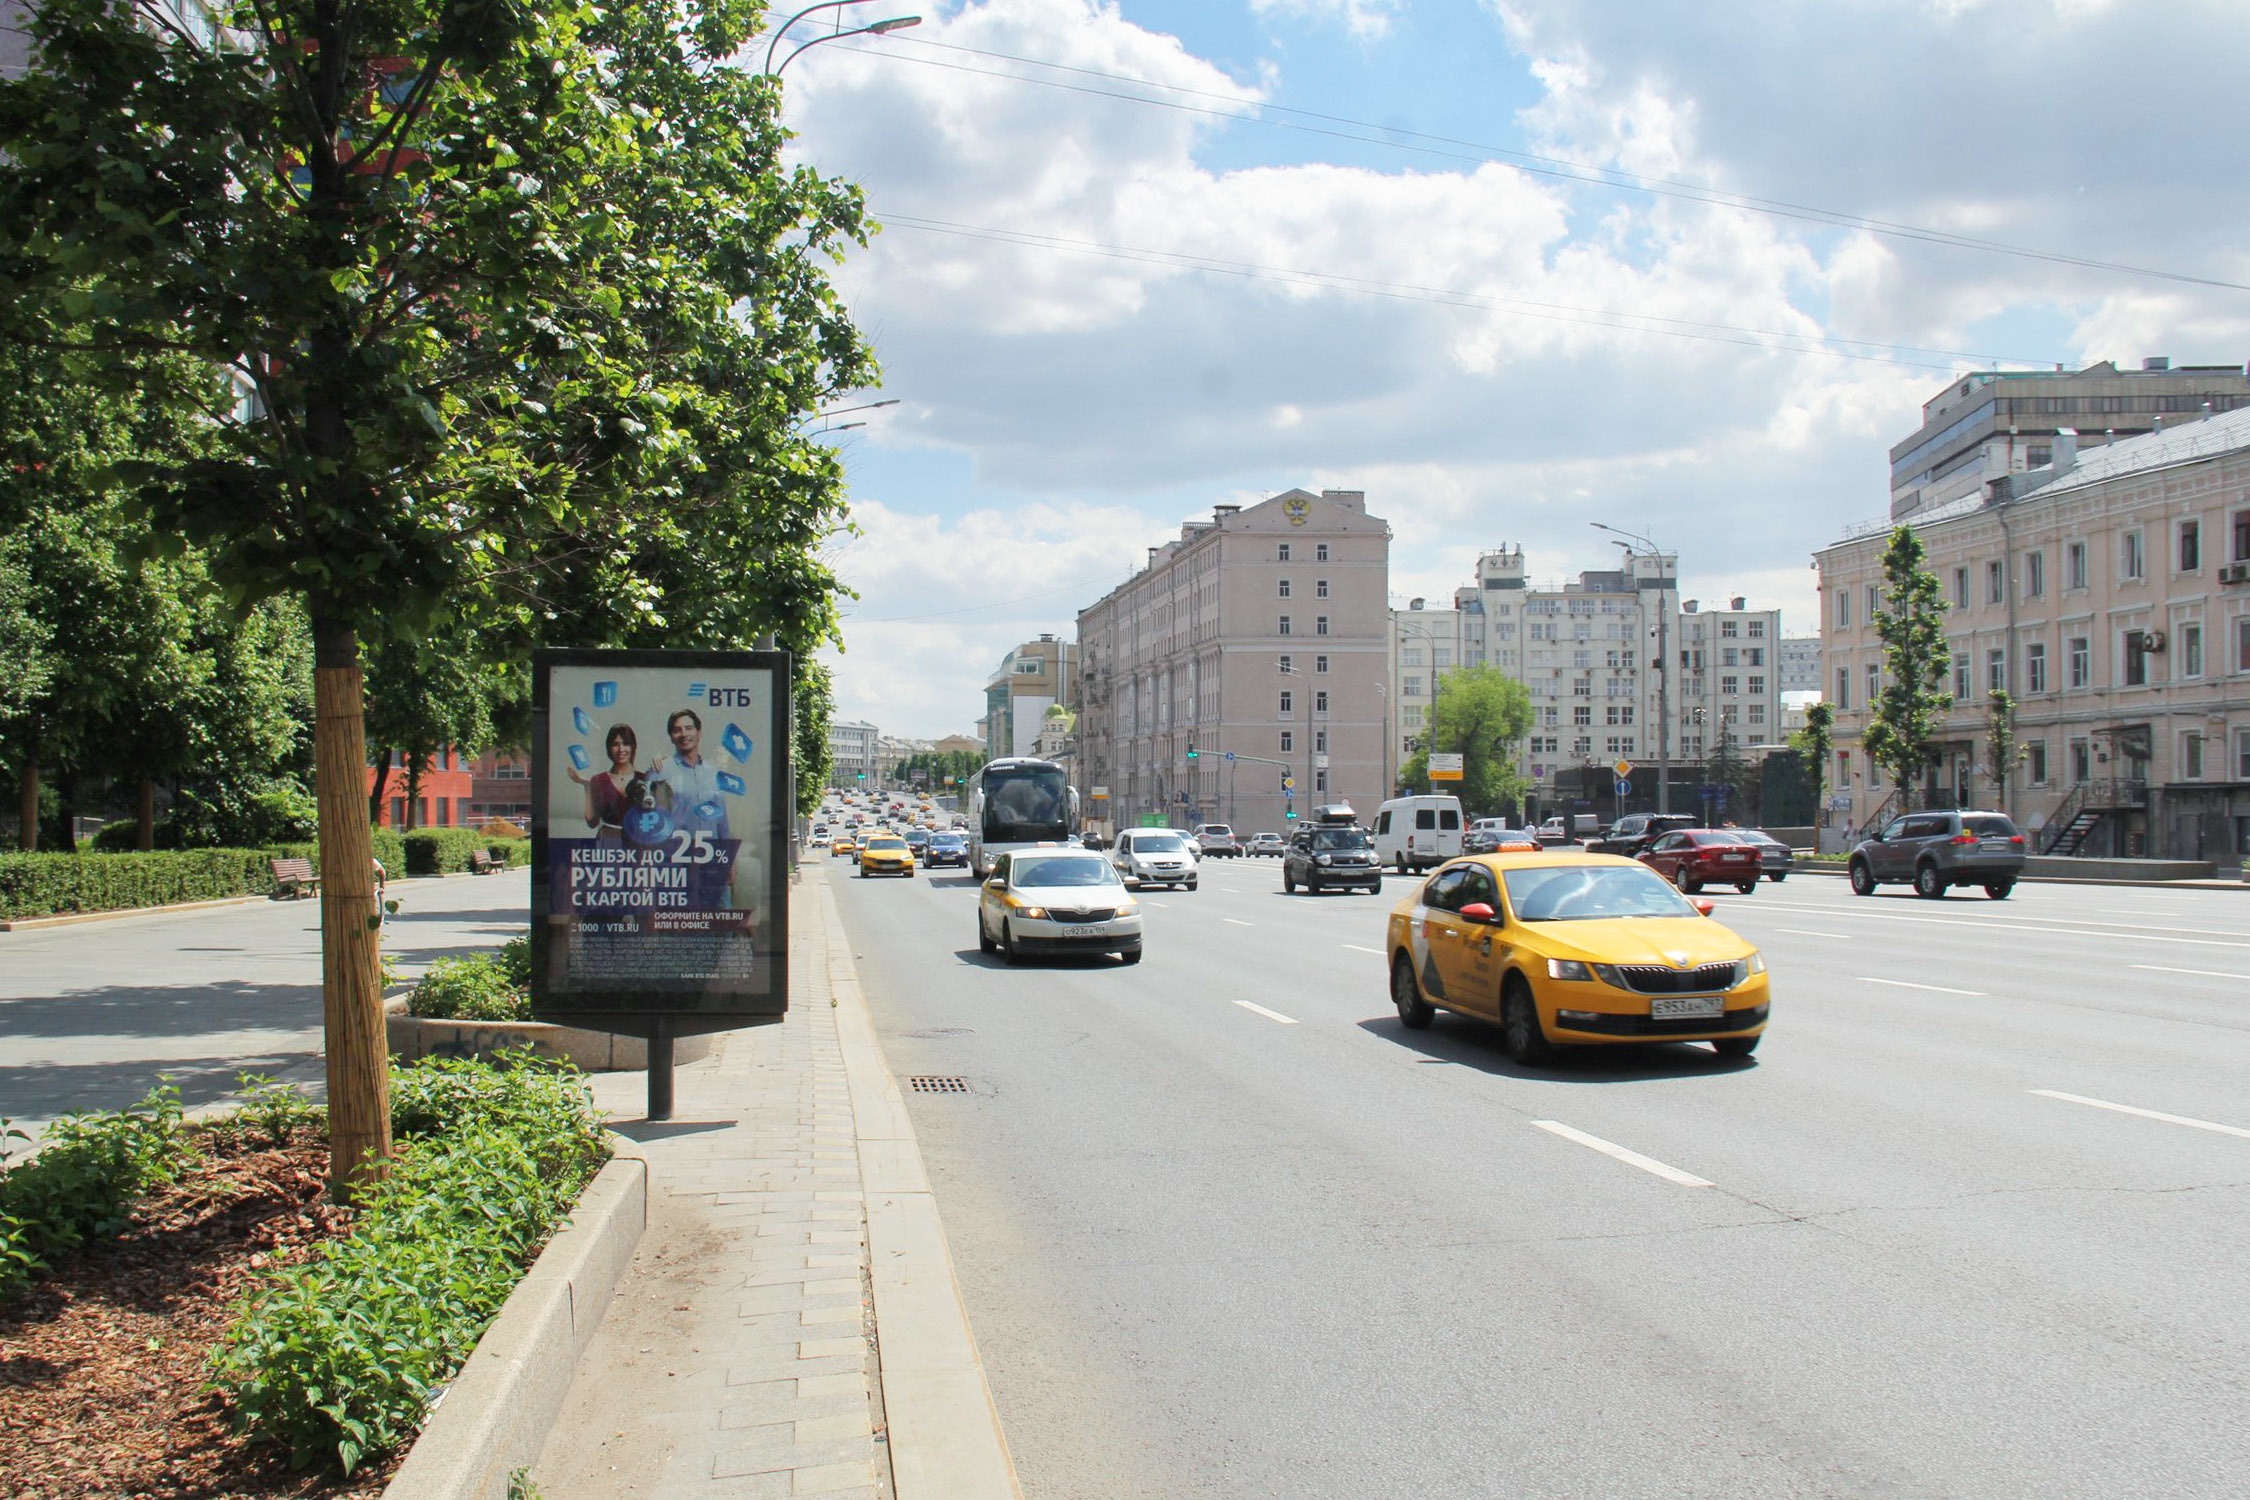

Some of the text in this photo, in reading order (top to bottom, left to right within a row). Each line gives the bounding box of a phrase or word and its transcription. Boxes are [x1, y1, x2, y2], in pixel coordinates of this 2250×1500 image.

[709, 688, 751, 707] ВТБ
[571, 829, 729, 866] КЕШБЭК ДО 25%
[571, 867, 688, 888] РУБЛЯМИ
[572, 888, 688, 907] С КАРТОЙ ВТБ
[654, 911, 744, 921] ОФОРМИТЕ НА VTB.RU
[654, 921, 710, 930] ИЛИ В ОФИСЕ
[577, 923, 599, 933] 1000
[607, 923, 639, 933] VTB.RU
